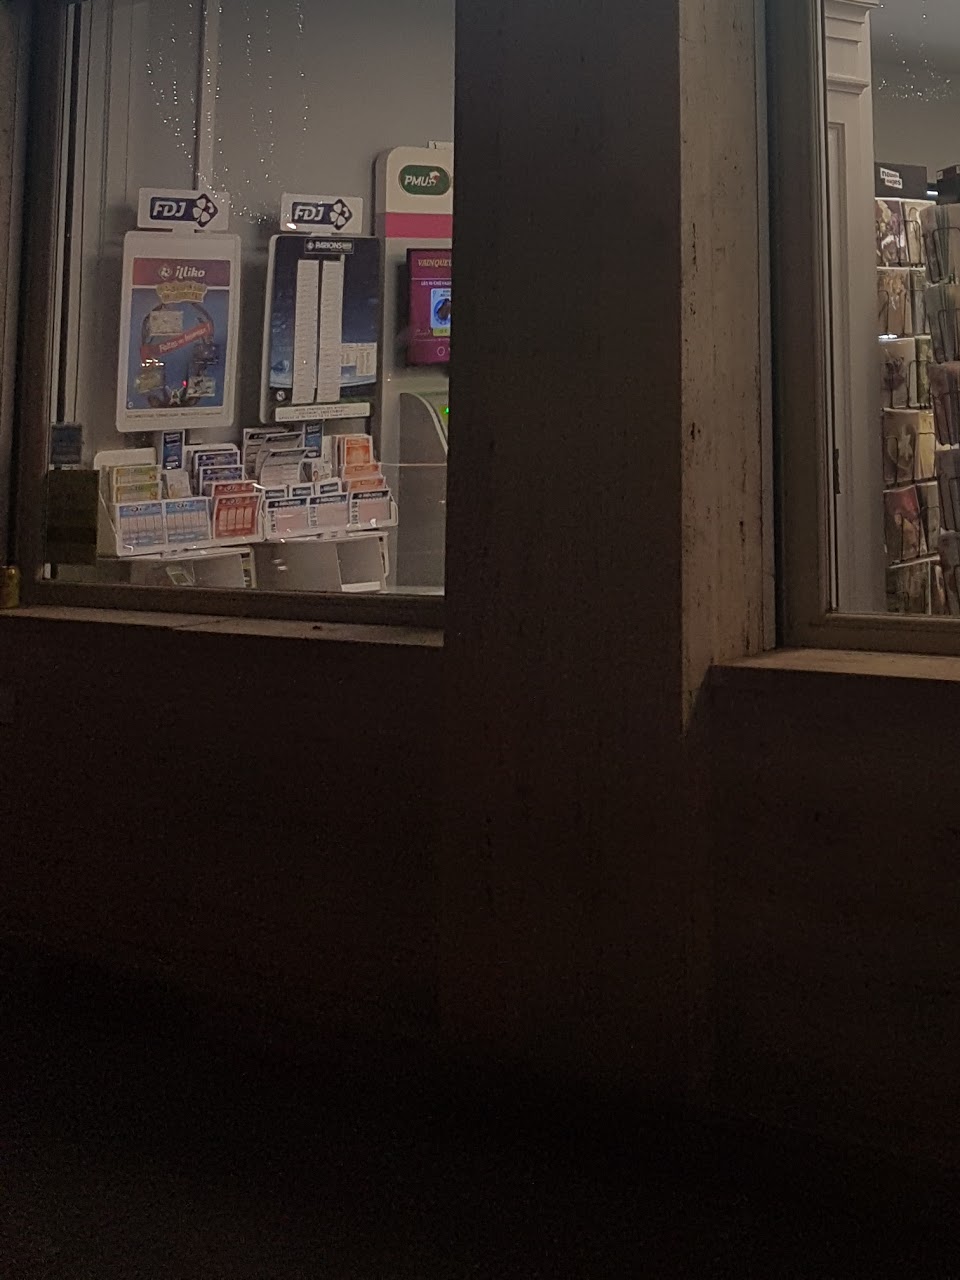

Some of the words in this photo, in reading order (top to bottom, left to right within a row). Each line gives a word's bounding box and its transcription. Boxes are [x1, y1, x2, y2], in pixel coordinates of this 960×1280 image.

[404, 174, 429, 187] PMU
[152, 201, 187, 218] FDJ
[294, 205, 325, 220] FDJ
[175, 265, 206, 279] illiko
